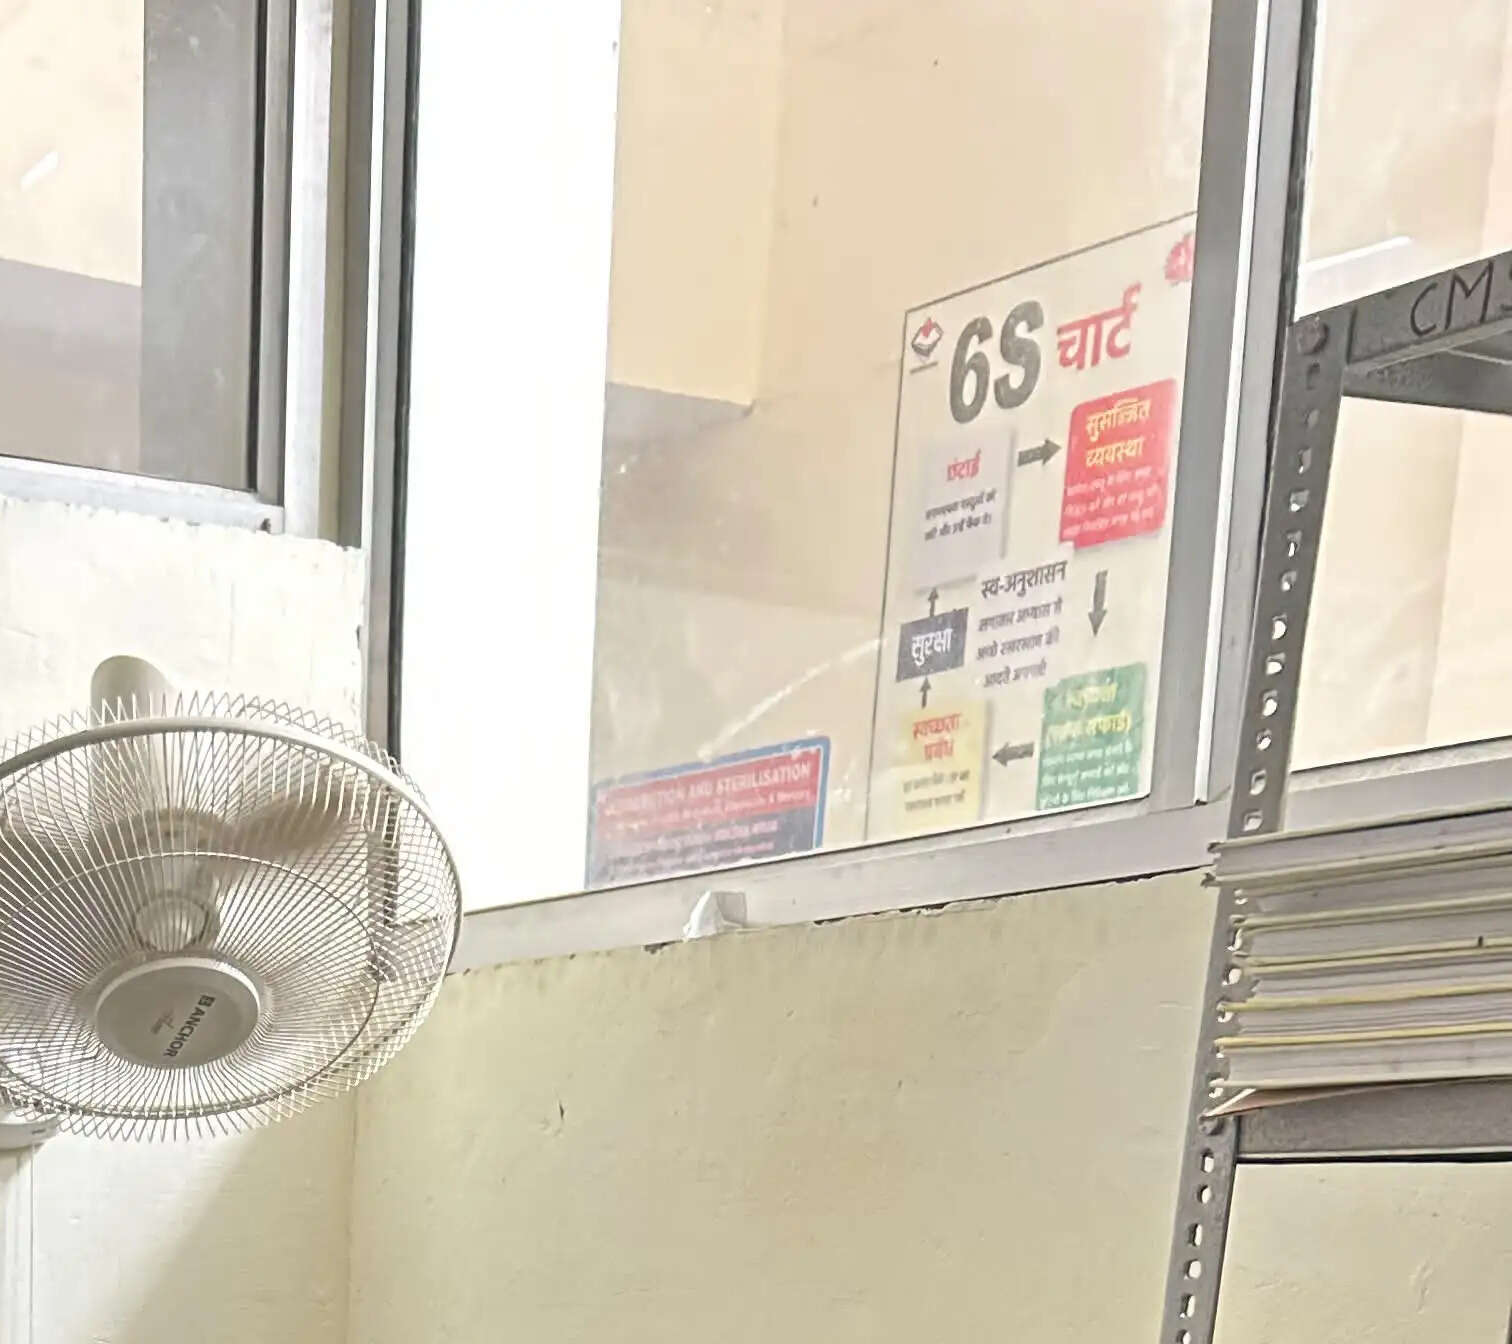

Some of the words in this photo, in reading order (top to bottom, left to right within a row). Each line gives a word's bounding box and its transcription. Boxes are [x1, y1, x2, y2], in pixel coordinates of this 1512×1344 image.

[950, 300, 1044, 424] 6S
[1057, 284, 1142, 371] चार्ट
[911, 628, 953, 667] सुरक्षा
[163, 1007, 206, 1058] ANCHOR
